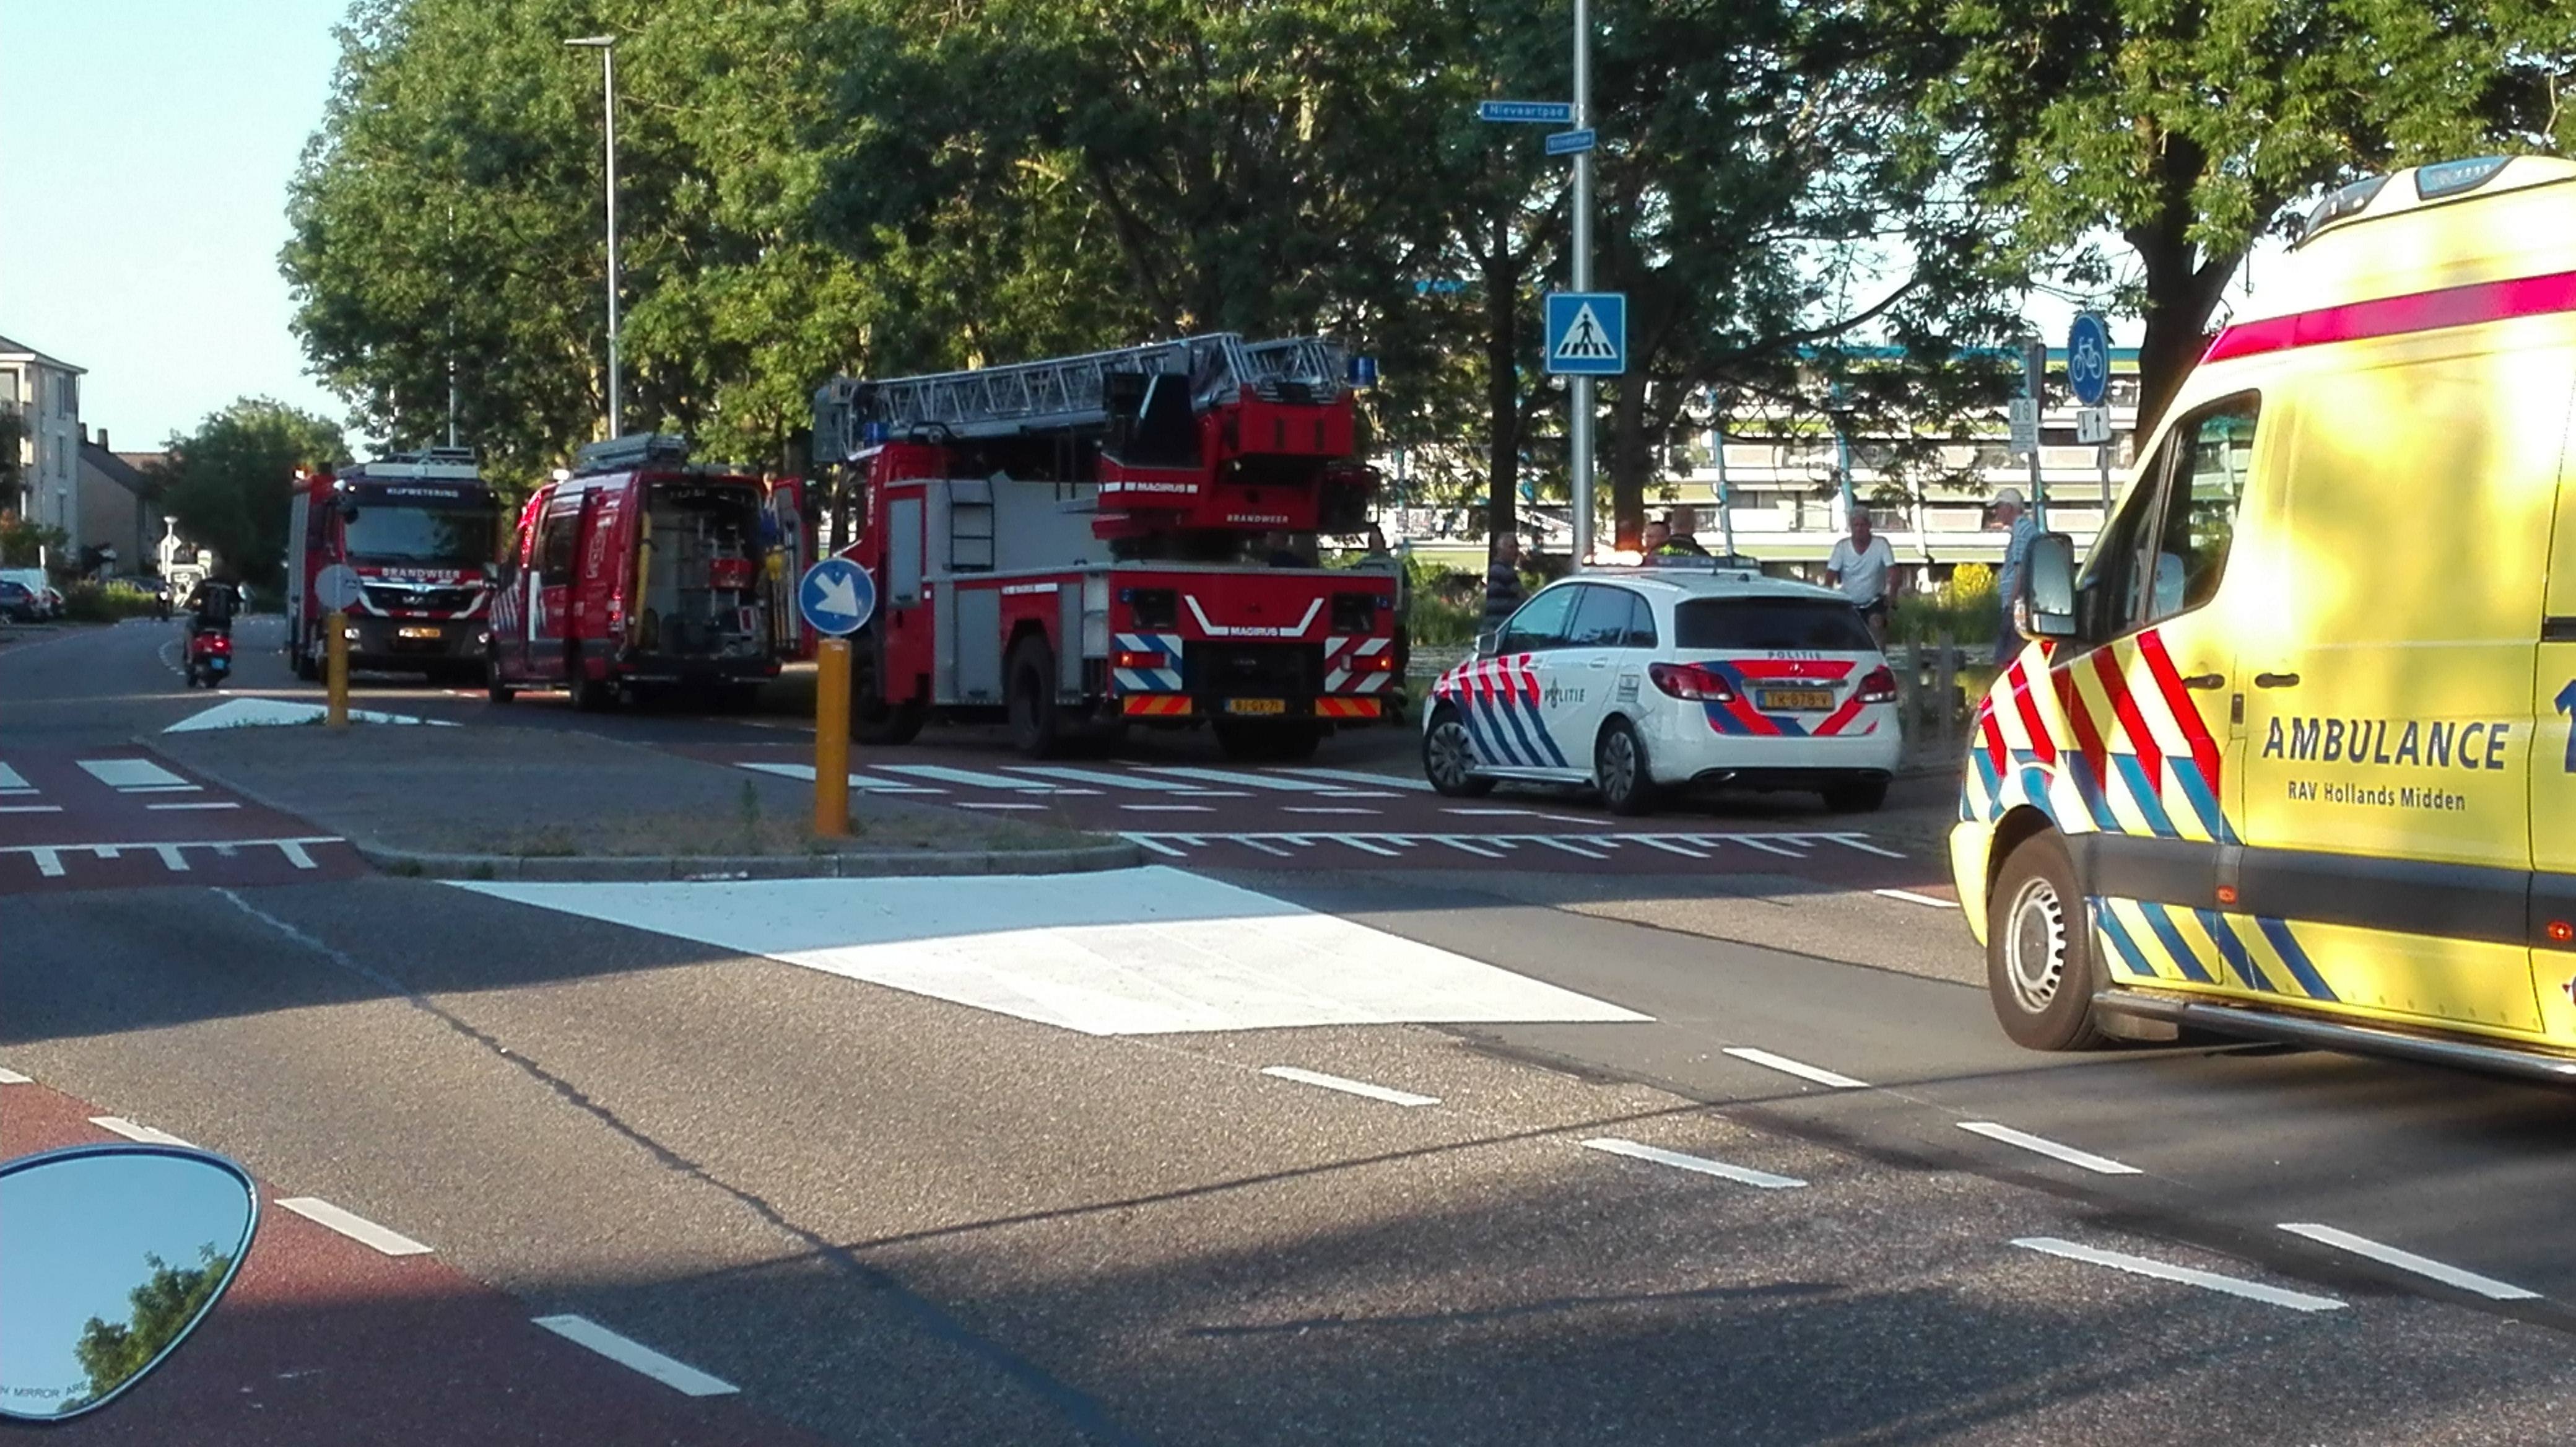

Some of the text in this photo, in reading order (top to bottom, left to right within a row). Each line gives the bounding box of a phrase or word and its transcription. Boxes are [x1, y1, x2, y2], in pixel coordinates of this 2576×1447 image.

[1138, 482, 1185, 493] MAGIRUS
[1227, 514, 1289, 523] BRANDWEER
[382, 567, 460, 579] BRANDWEER
[1230, 626, 1279, 636] MAGIRUS
[1768, 651, 1821, 660] POLITIE
[2262, 716, 2510, 770] AMBULANCE
[2288, 780, 2465, 811] RAV Hollands Midden
[14, 1388, 60, 1399] MIRROR
[66, 1380, 89, 1396] ARE
